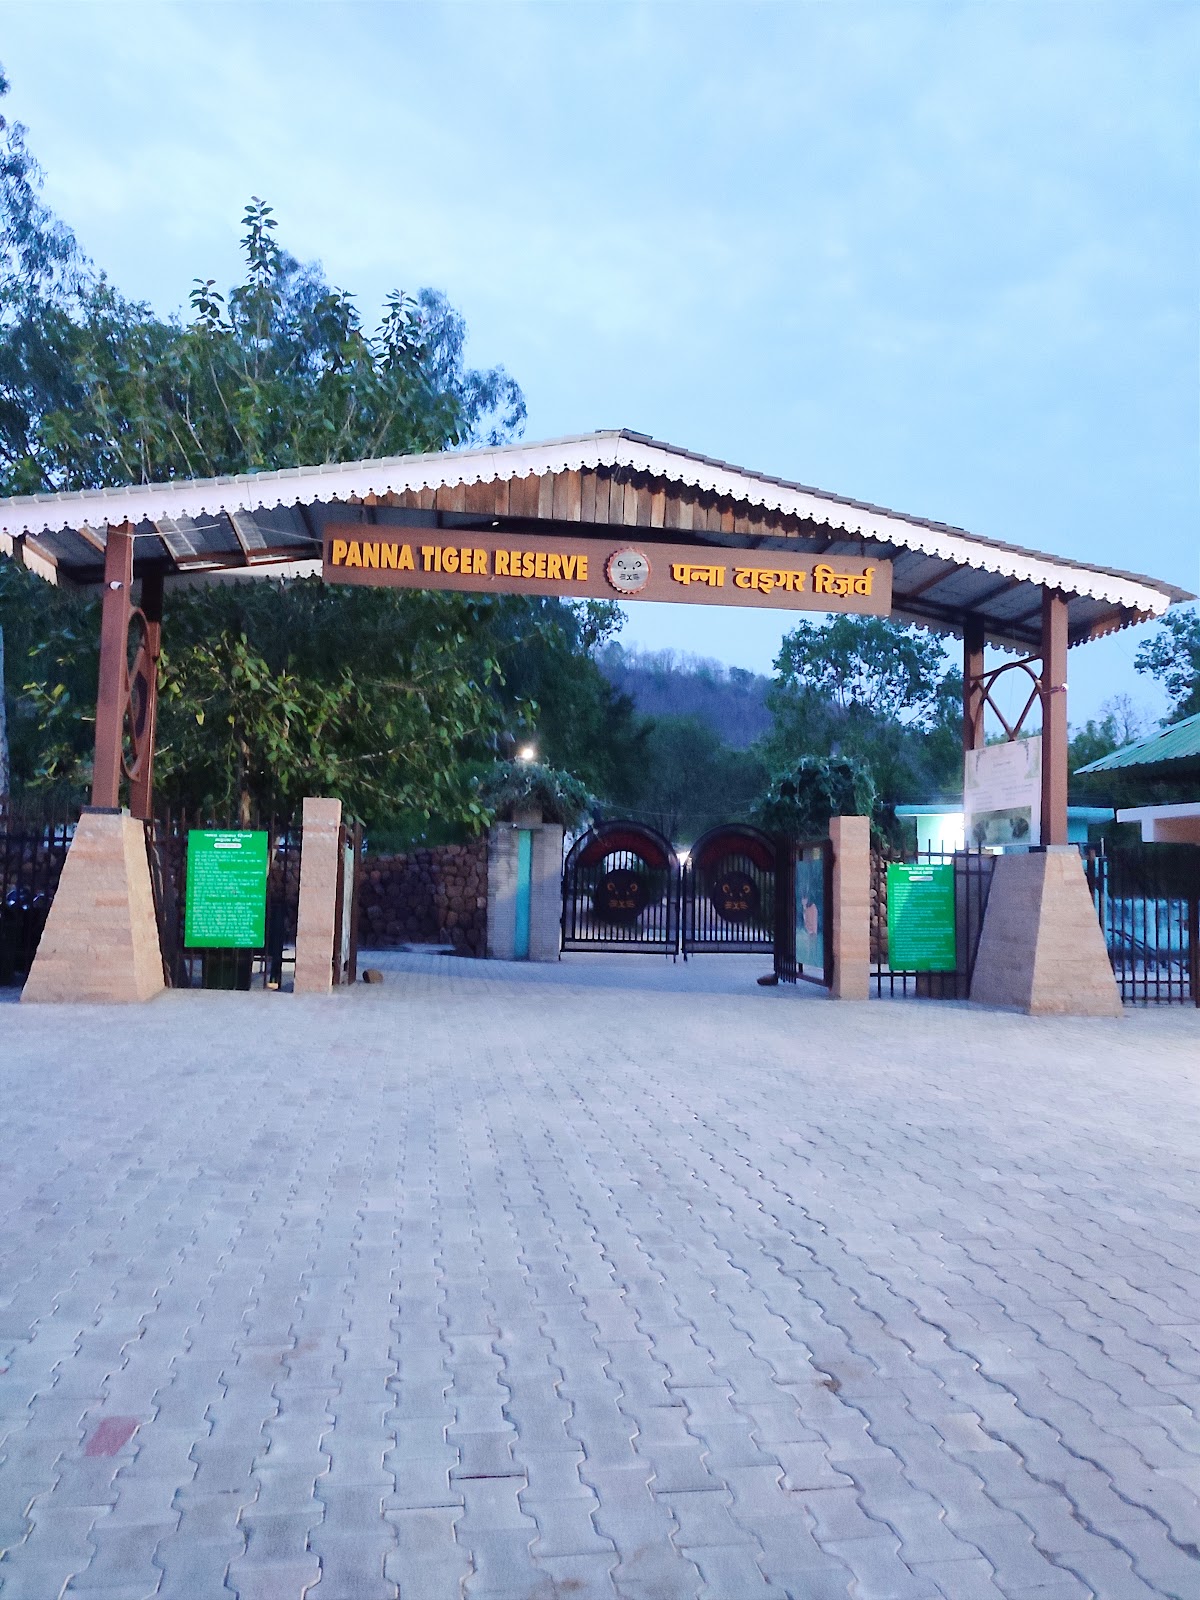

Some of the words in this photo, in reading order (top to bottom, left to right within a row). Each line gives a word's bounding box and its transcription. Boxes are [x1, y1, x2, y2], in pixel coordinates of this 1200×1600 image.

[332, 539, 415, 570] PANNA
[422, 545, 488, 575] TIGER
[494, 549, 588, 581] RESERVE
[671, 563, 726, 587] पन्ना
[734, 567, 806, 594] टाइगर
